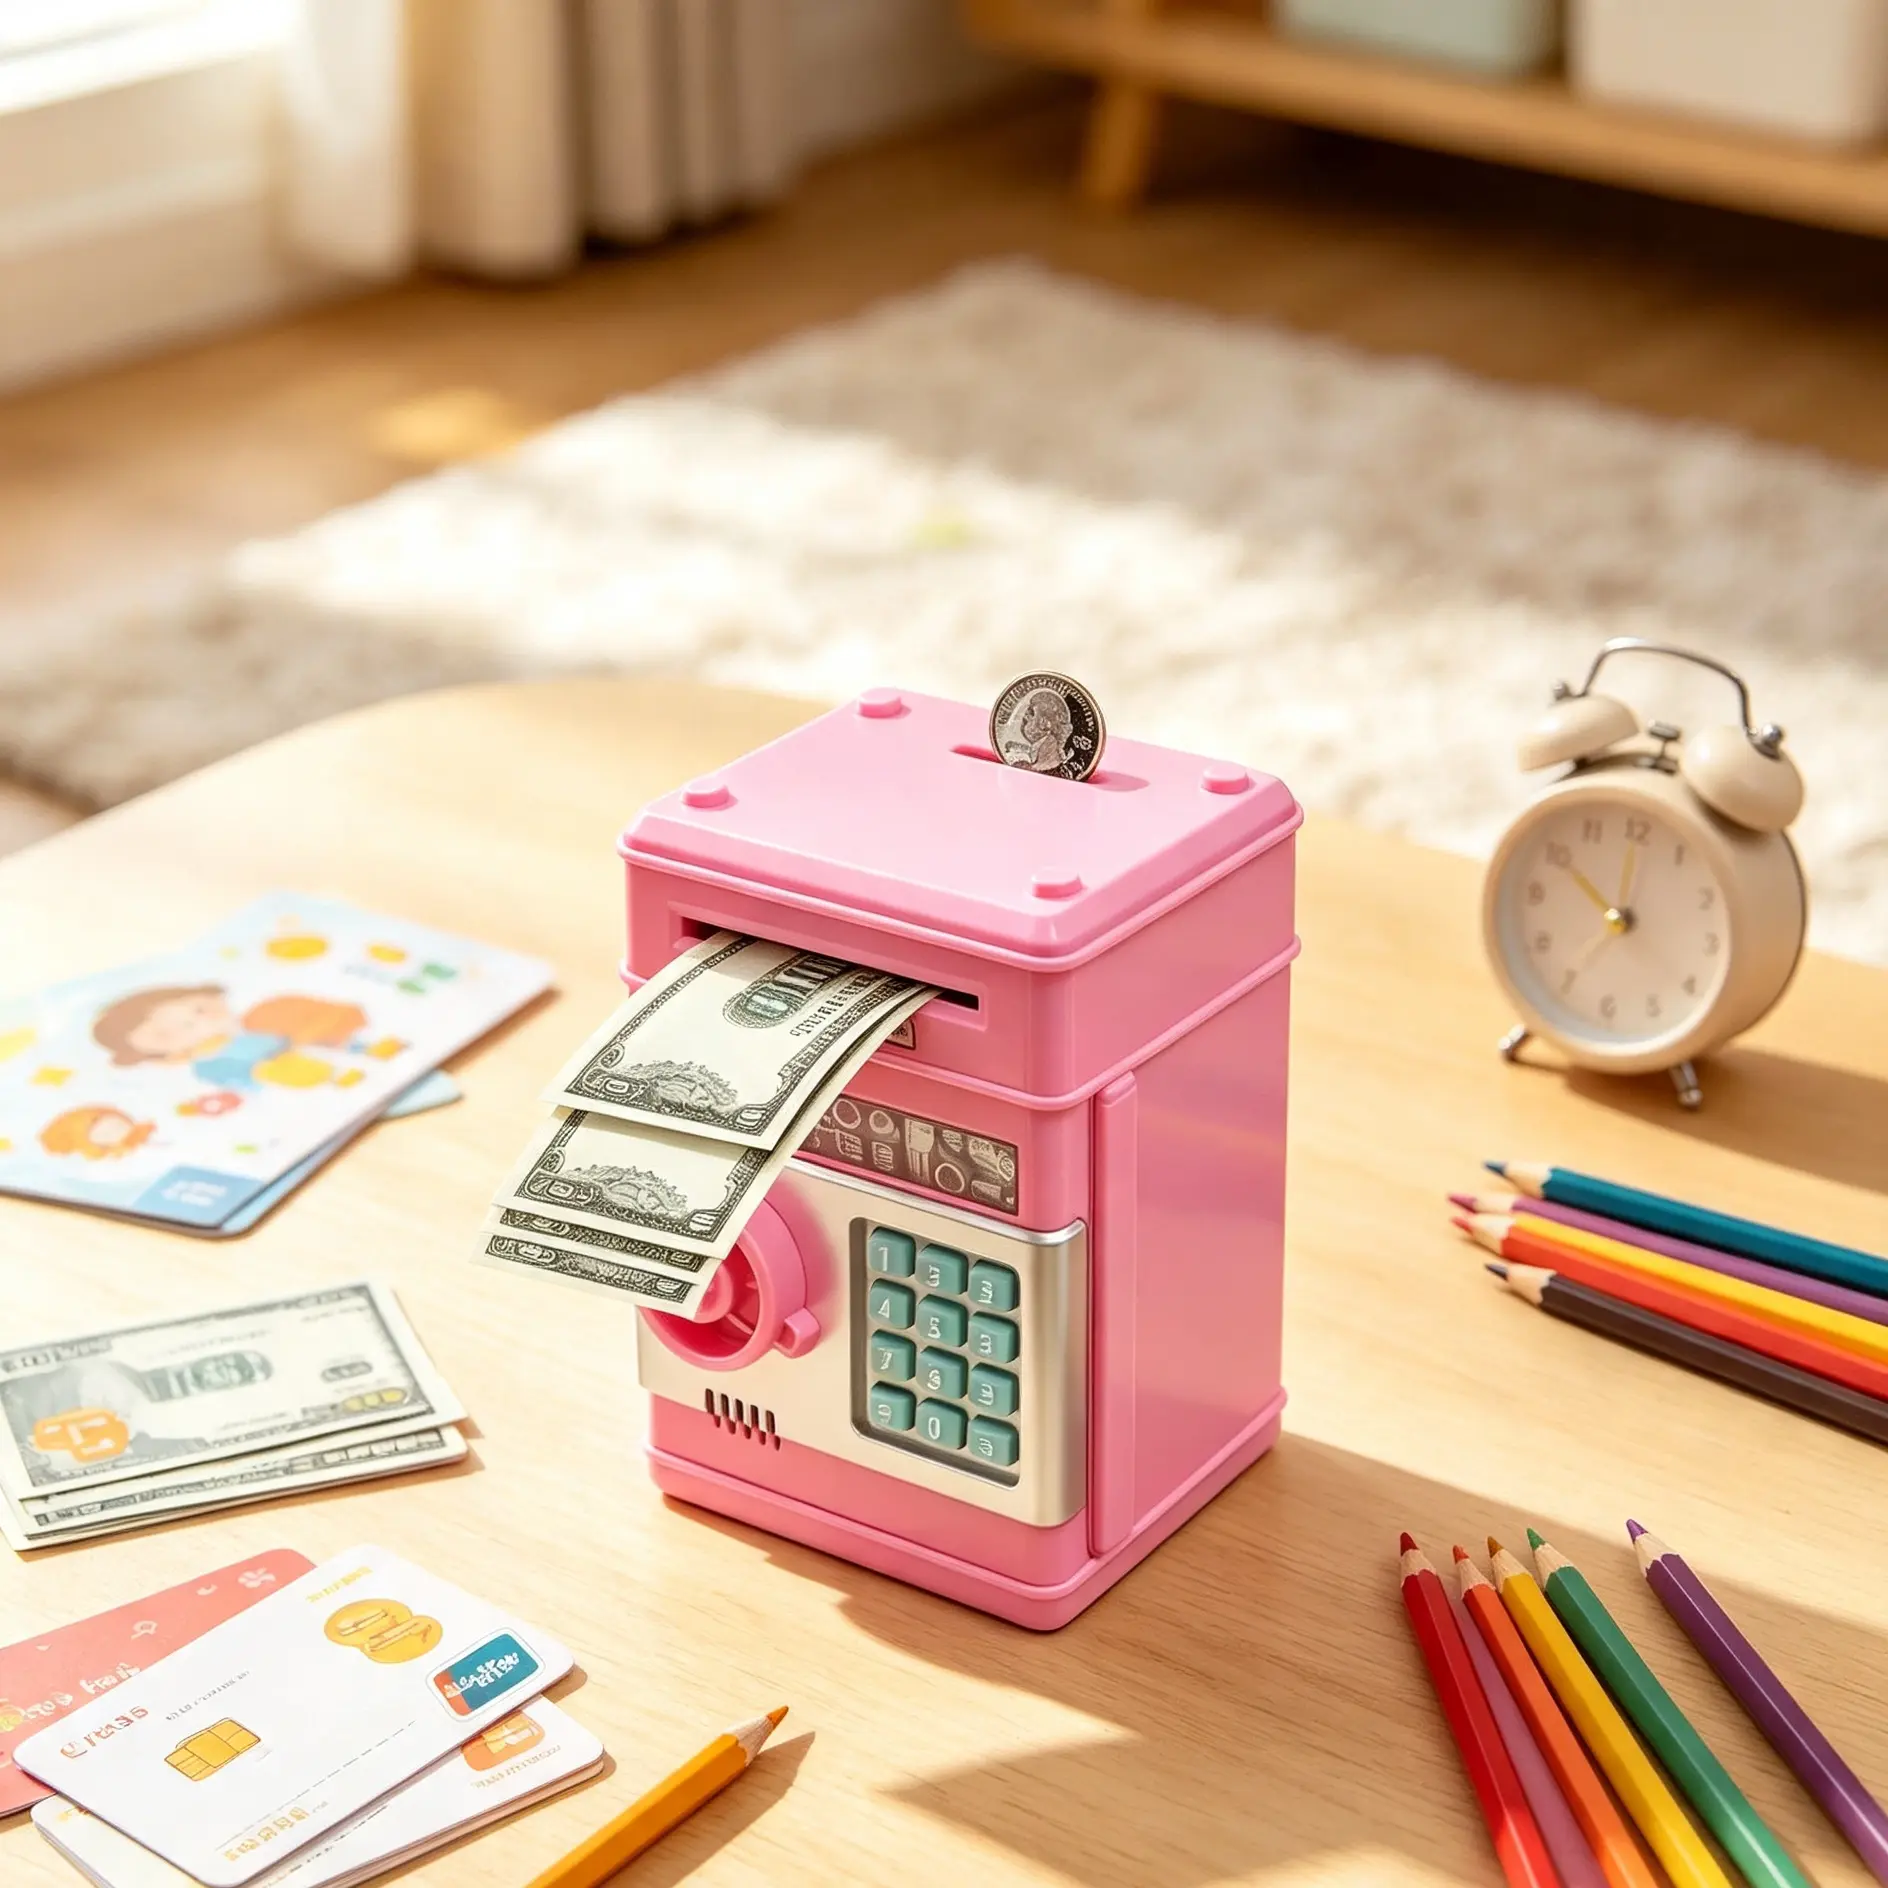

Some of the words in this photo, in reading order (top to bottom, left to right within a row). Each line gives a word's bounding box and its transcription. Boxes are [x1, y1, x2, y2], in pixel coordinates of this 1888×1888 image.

[1582, 819, 1603, 844] 11
[1624, 817, 1652, 845] 12
[1673, 844, 1685, 865] 1
[878, 1246, 889, 1271] 1
[877, 1297, 891, 1319] 4
[877, 1346, 892, 1371] 7
[928, 1416, 941, 1440] 0
